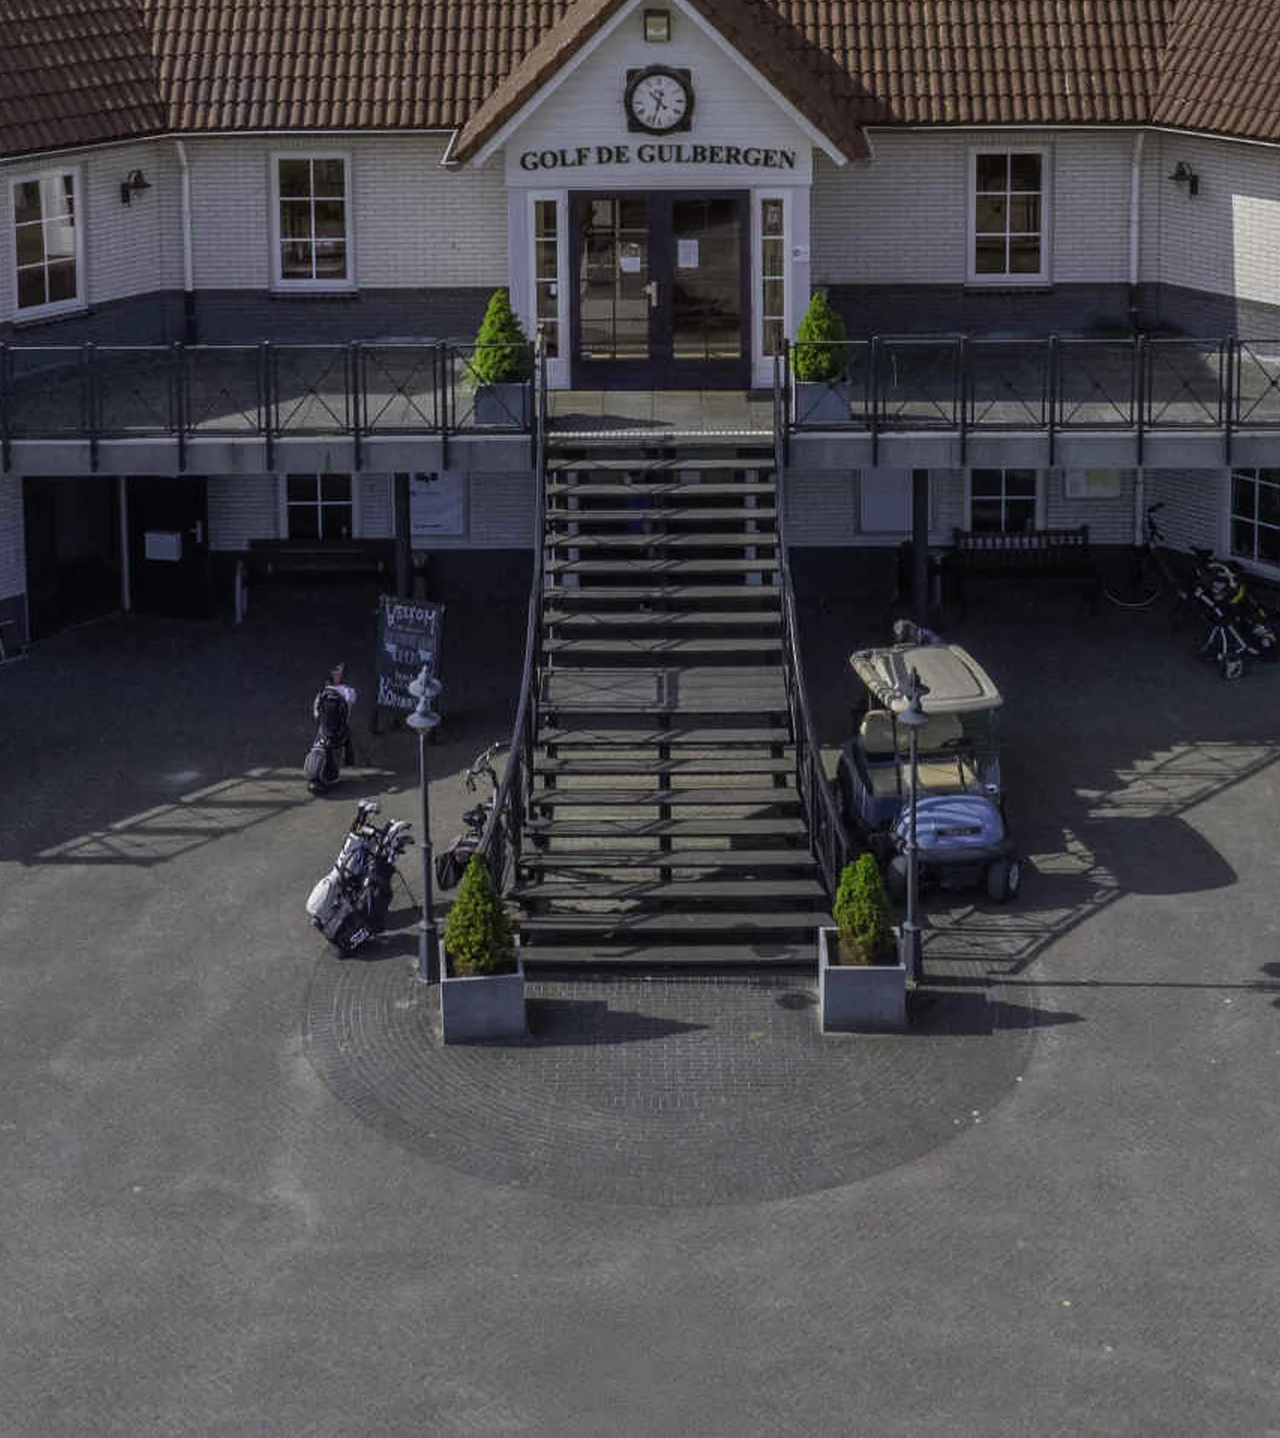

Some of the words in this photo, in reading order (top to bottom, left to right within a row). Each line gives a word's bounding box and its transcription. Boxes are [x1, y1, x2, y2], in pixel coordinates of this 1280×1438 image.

[519, 147, 591, 171] GOLF
[597, 145, 630, 165] DE
[637, 144, 796, 170] GULBERGEN
